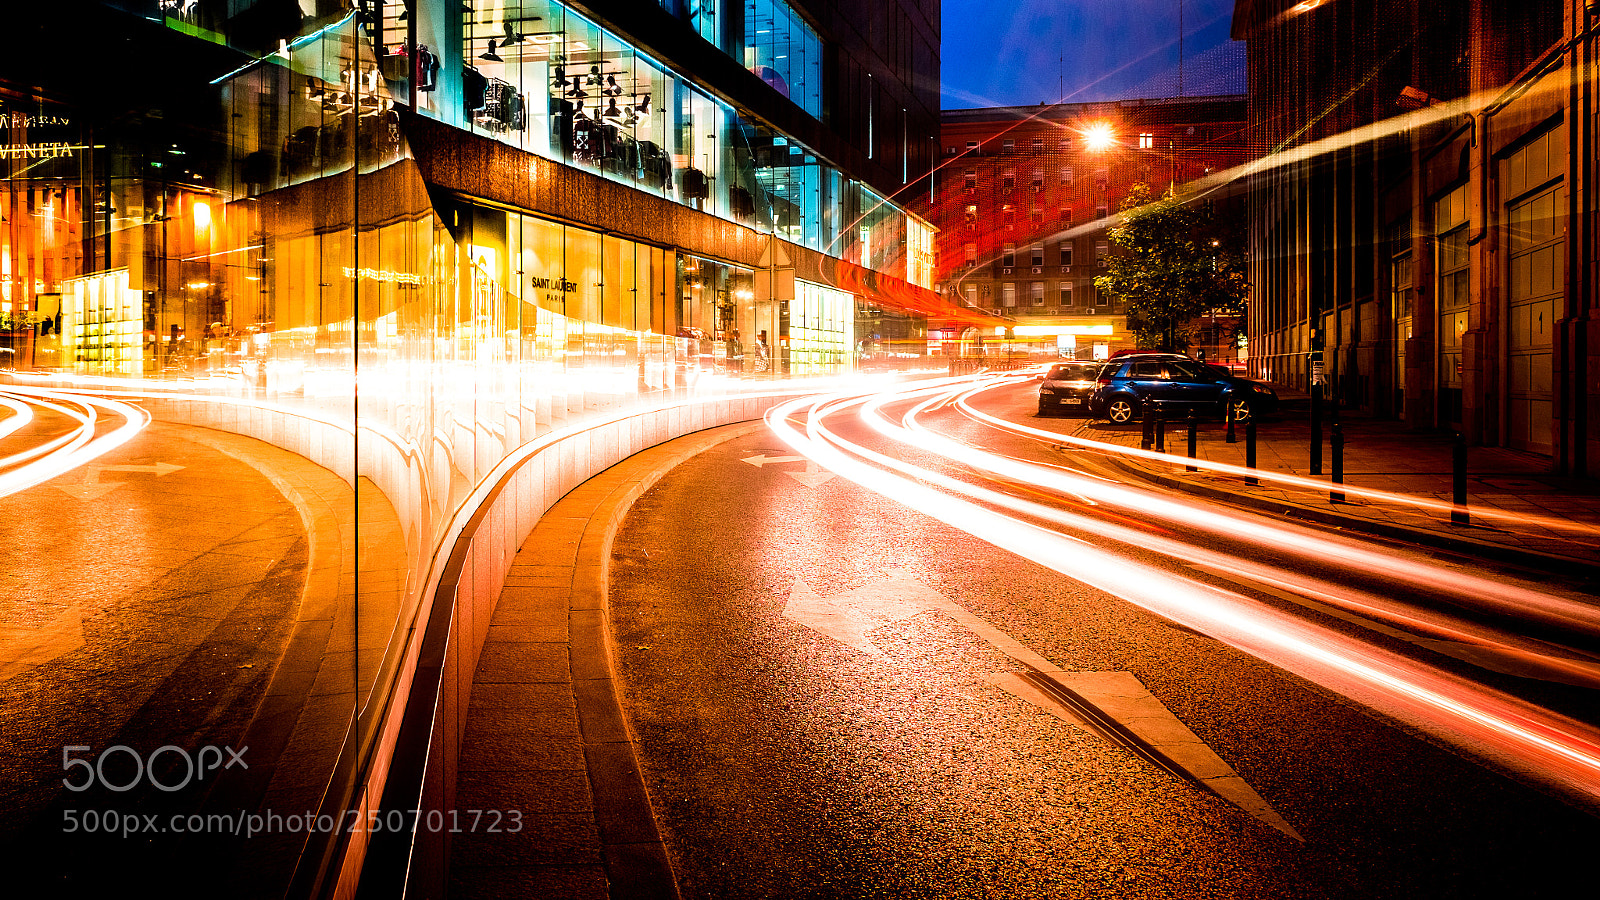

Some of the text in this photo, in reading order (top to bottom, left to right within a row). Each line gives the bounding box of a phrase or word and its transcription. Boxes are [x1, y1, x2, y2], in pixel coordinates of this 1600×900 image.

[0, 142, 73, 159] VENETA
[532, 276, 550, 289] SAINT
[1538, 311, 1543, 335] 1
